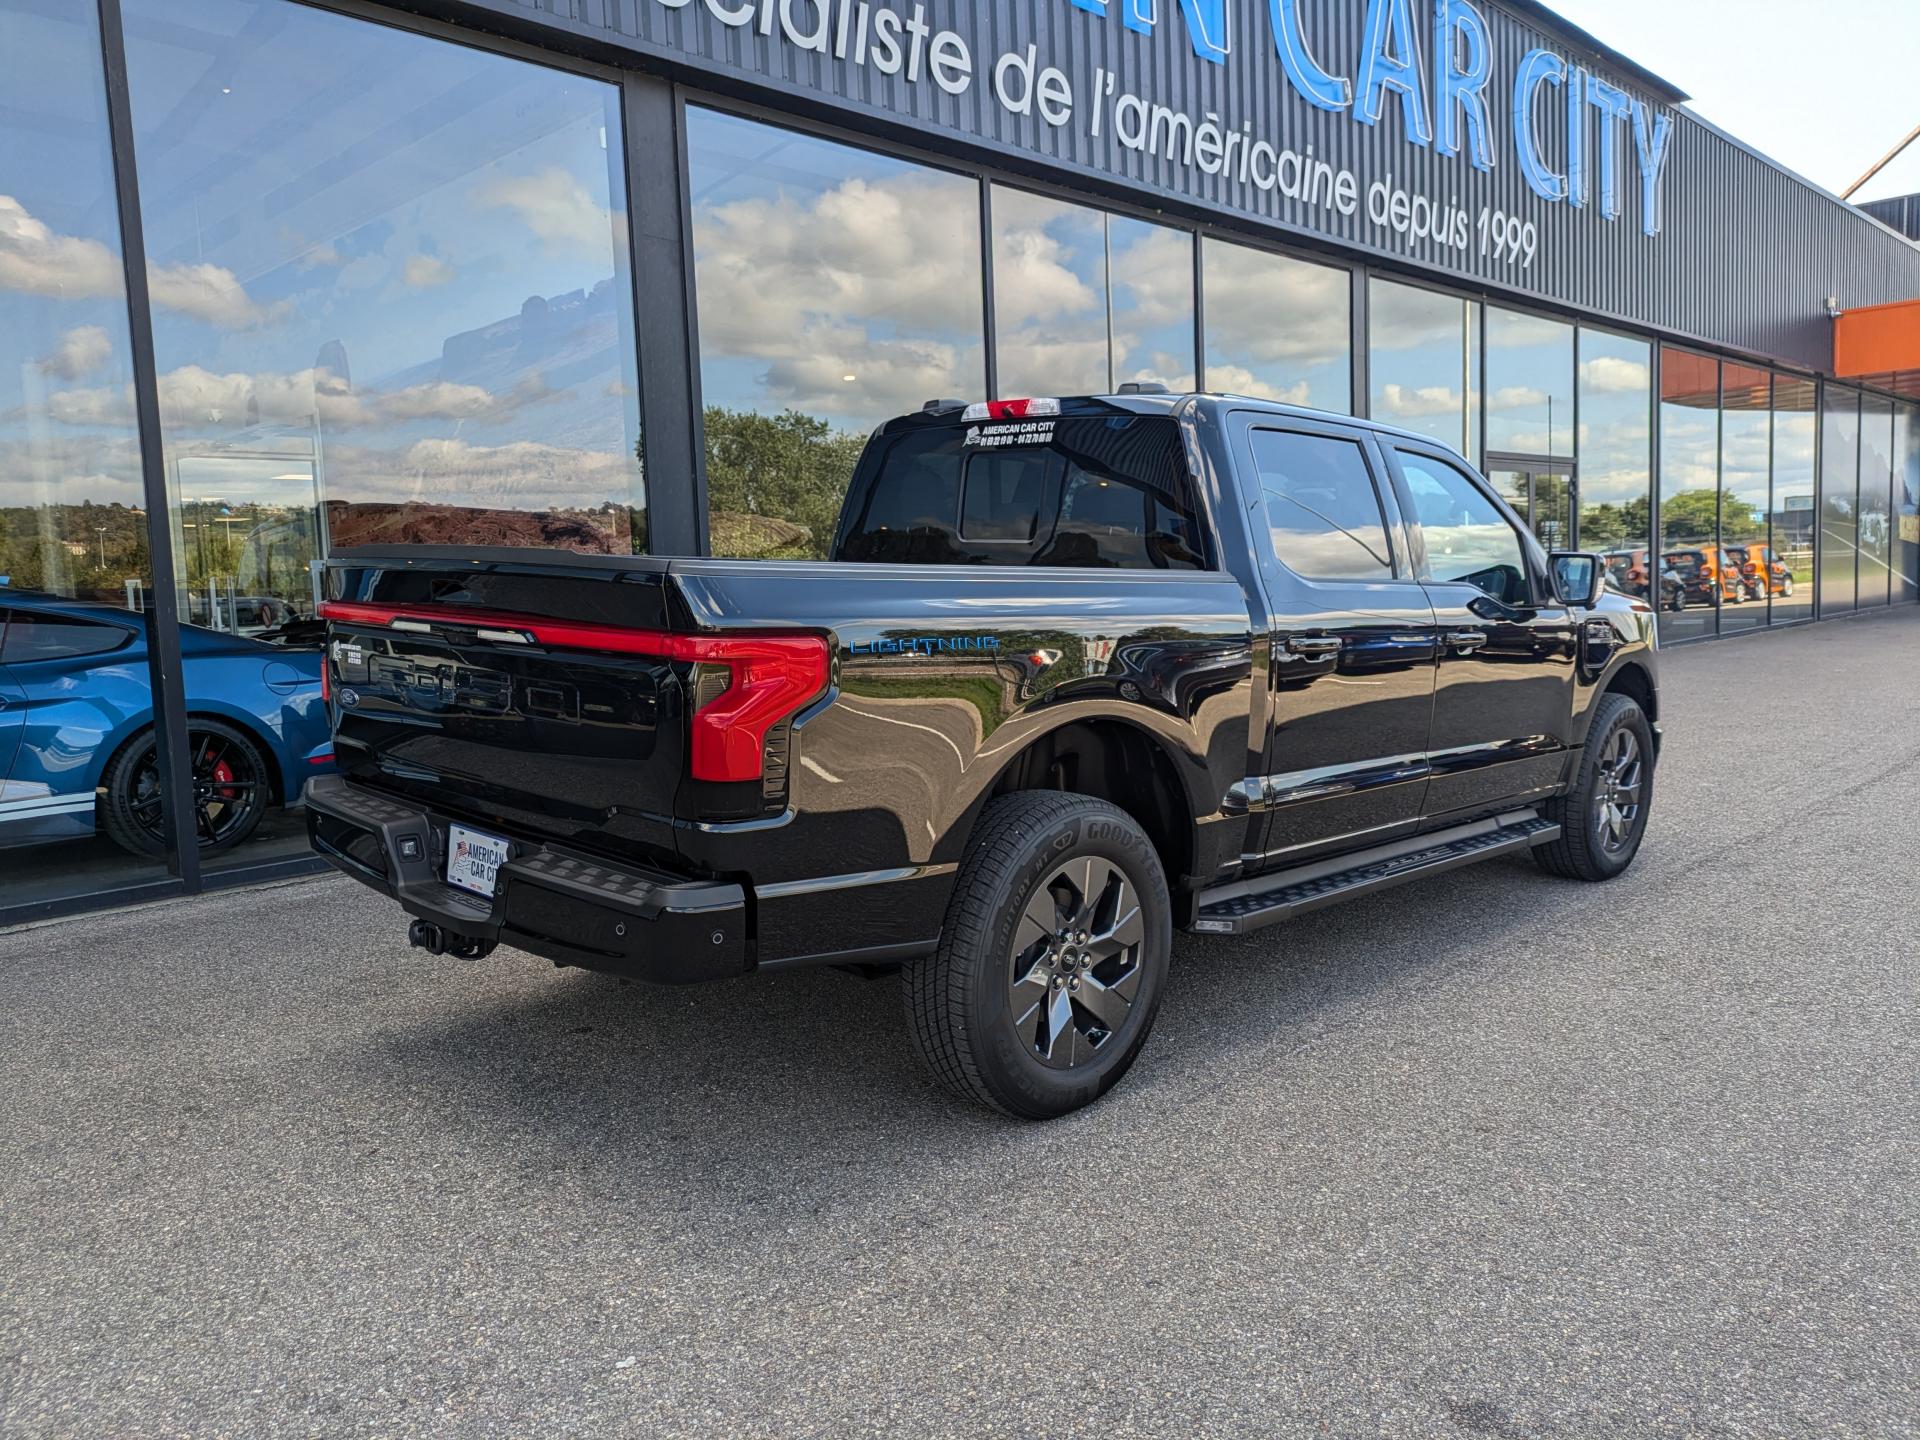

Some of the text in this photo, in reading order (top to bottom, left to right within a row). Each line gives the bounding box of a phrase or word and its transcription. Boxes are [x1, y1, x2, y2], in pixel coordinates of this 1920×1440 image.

[1268, 0, 1674, 237] CAR CITY
[655, 0, 972, 95] aliste
[994, 43, 1073, 127] de
[1368, 172, 1468, 251] depuis
[1477, 207, 1538, 268] 1999
[982, 421, 1056, 436] AMERICAN CAR CITY
[850, 637, 1000, 656] LIGHTNING
[468, 843, 504, 866] AMERICAN
[471, 861, 485, 880] CAR
